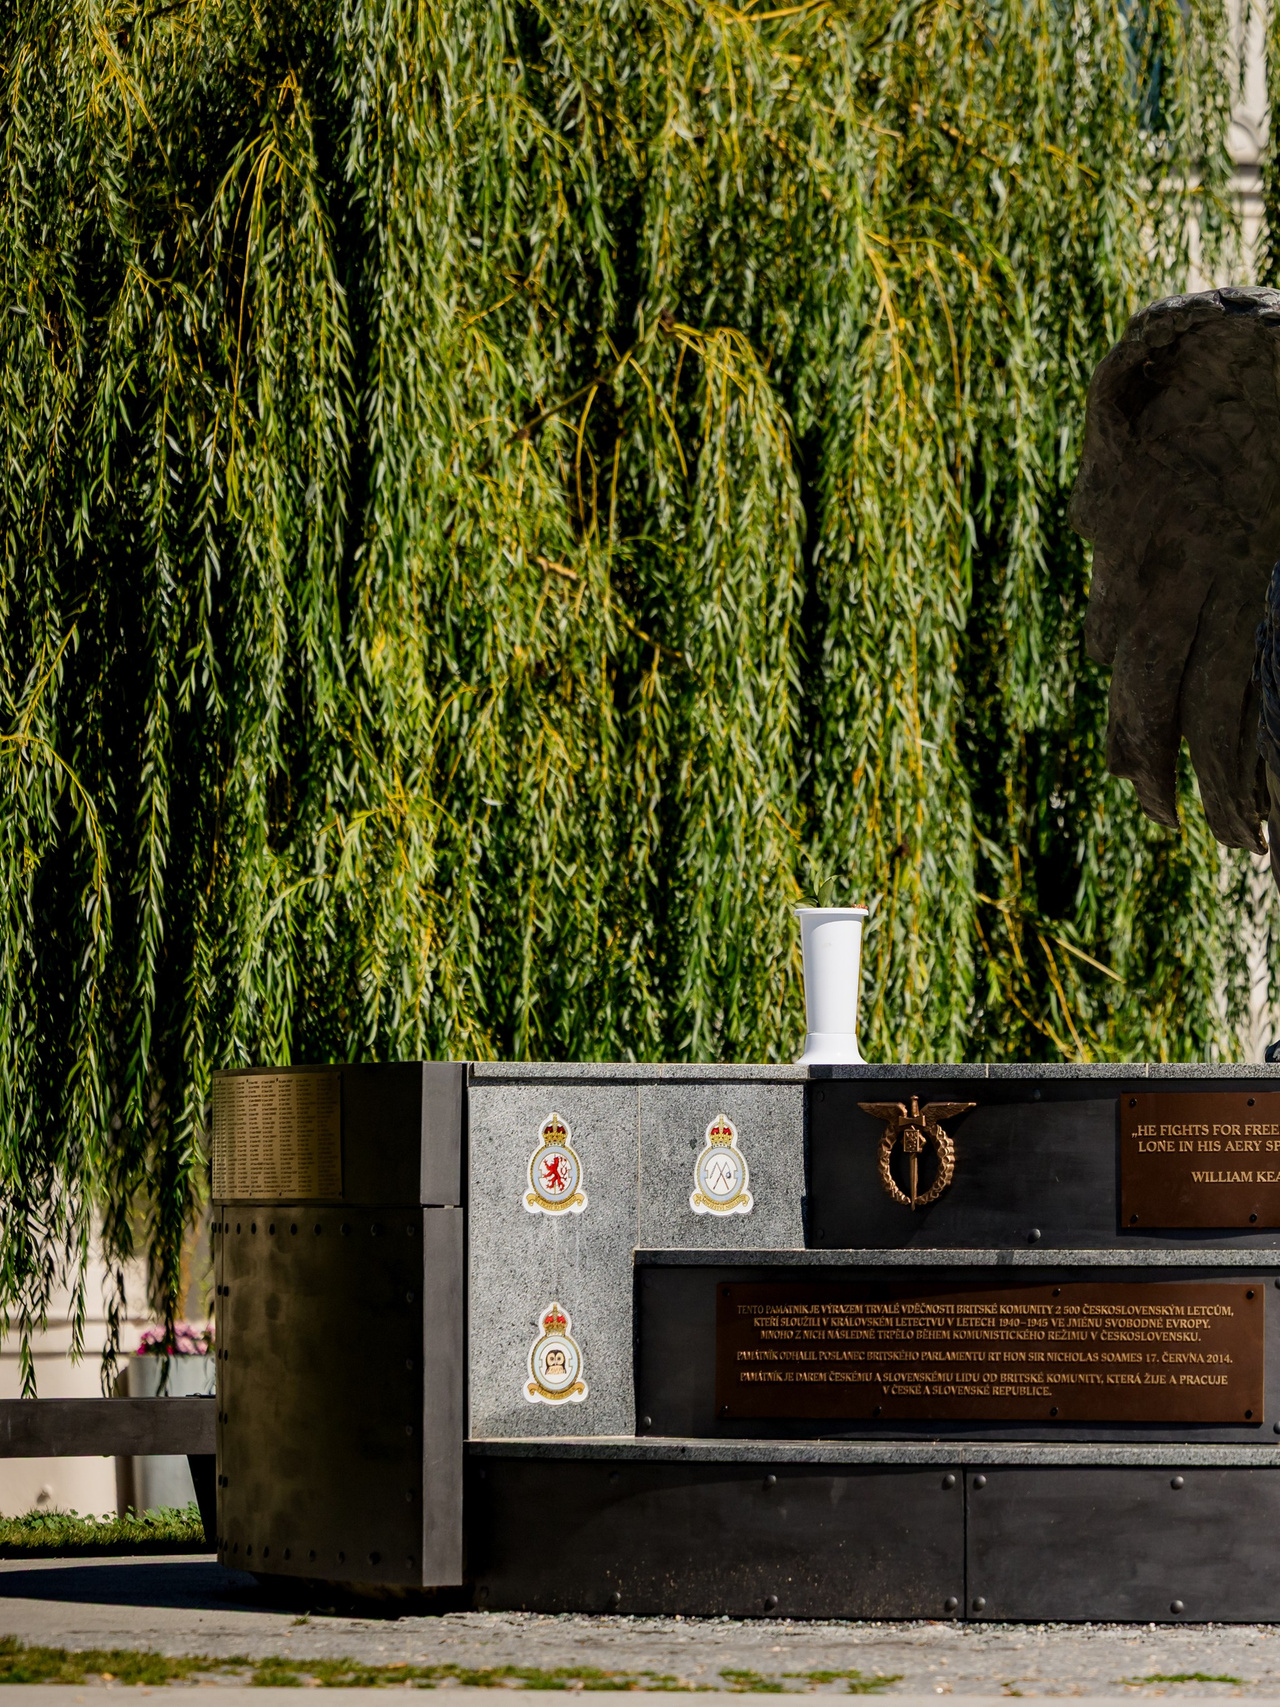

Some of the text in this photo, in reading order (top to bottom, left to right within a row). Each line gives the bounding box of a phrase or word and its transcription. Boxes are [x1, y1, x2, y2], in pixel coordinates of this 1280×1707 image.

[1160, 1124, 1209, 1135] FIGHTS
[1213, 1125, 1241, 1135] FOR
[1139, 1140, 1175, 1152] LONE
[1179, 1141, 1194, 1151] IN
[1198, 1141, 1221, 1151] HIS
[1225, 1141, 1262, 1151] AERY
[1192, 1171, 1252, 1182] WILLIAM
[766, 1305, 808, 1314] PAMÁTNÍK
[822, 1304, 863, 1313] VÝRAZEM
[865, 1303, 899, 1313] TRVALÉ
[901, 1303, 955, 1314] VDĚČNOSTI
[957, 1303, 997, 1314] BRITSKÉ
[1000, 1305, 1053, 1314] KOMUNITY
[1063, 1306, 1080, 1314] 500
[1082, 1304, 1184, 1315] ČESKOSLOVENSKÝM
[831, 1316, 893, 1326] KRÁLOVSKÉM
[895, 1317, 945, 1326] LETECTVU
[956, 1317, 995, 1327] LETECH
[1067, 1317, 1102, 1327] JMÉNU
[1104, 1317, 1163, 1328] SVOBODNÉ
[1166, 1319, 1211, 1328] EVROPY.
[827, 1329, 1201, 1341] NÁSLEDNĚ TRPĚLO BĚHEM KOMUNISTICKÉHO REŽIMU ČESKOSLOVENSKU.
[737, 1350, 1232, 1363] PAMÁTNÍK ODHALIL POSLANEC BRITSKÉHO PARLAMENTU HON SIR NICHOLAS SOAMES ČERVNA 2014.
[740, 1371, 1228, 1384] PAMÁTNÍK DAREM ČESKÉMU SLOVENSKÉMU LIDU BRITSKÉ KOMUNITY, KTERÁ ŽIJE PRACUJE
[891, 1384, 1052, 1395] ČESKÉ SLOVENSKÉ REPUBLICE.
